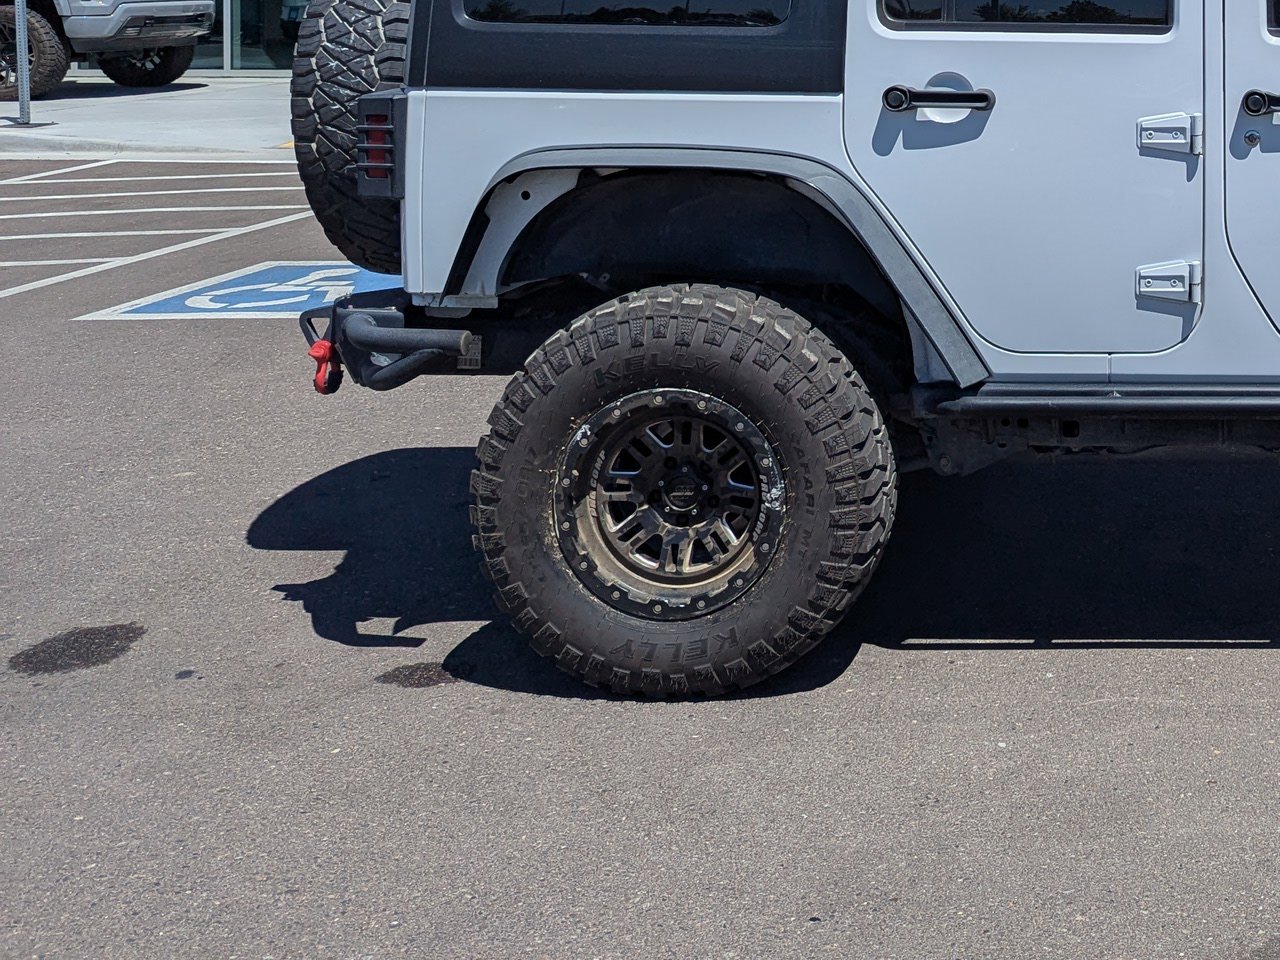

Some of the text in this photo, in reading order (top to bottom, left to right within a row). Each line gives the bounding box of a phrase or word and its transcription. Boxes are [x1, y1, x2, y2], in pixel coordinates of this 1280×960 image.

[594, 352, 720, 388] KELLY
[590, 450, 606, 488] COMP
[752, 504, 768, 542] COMP
[609, 626, 739, 663] KELLY
